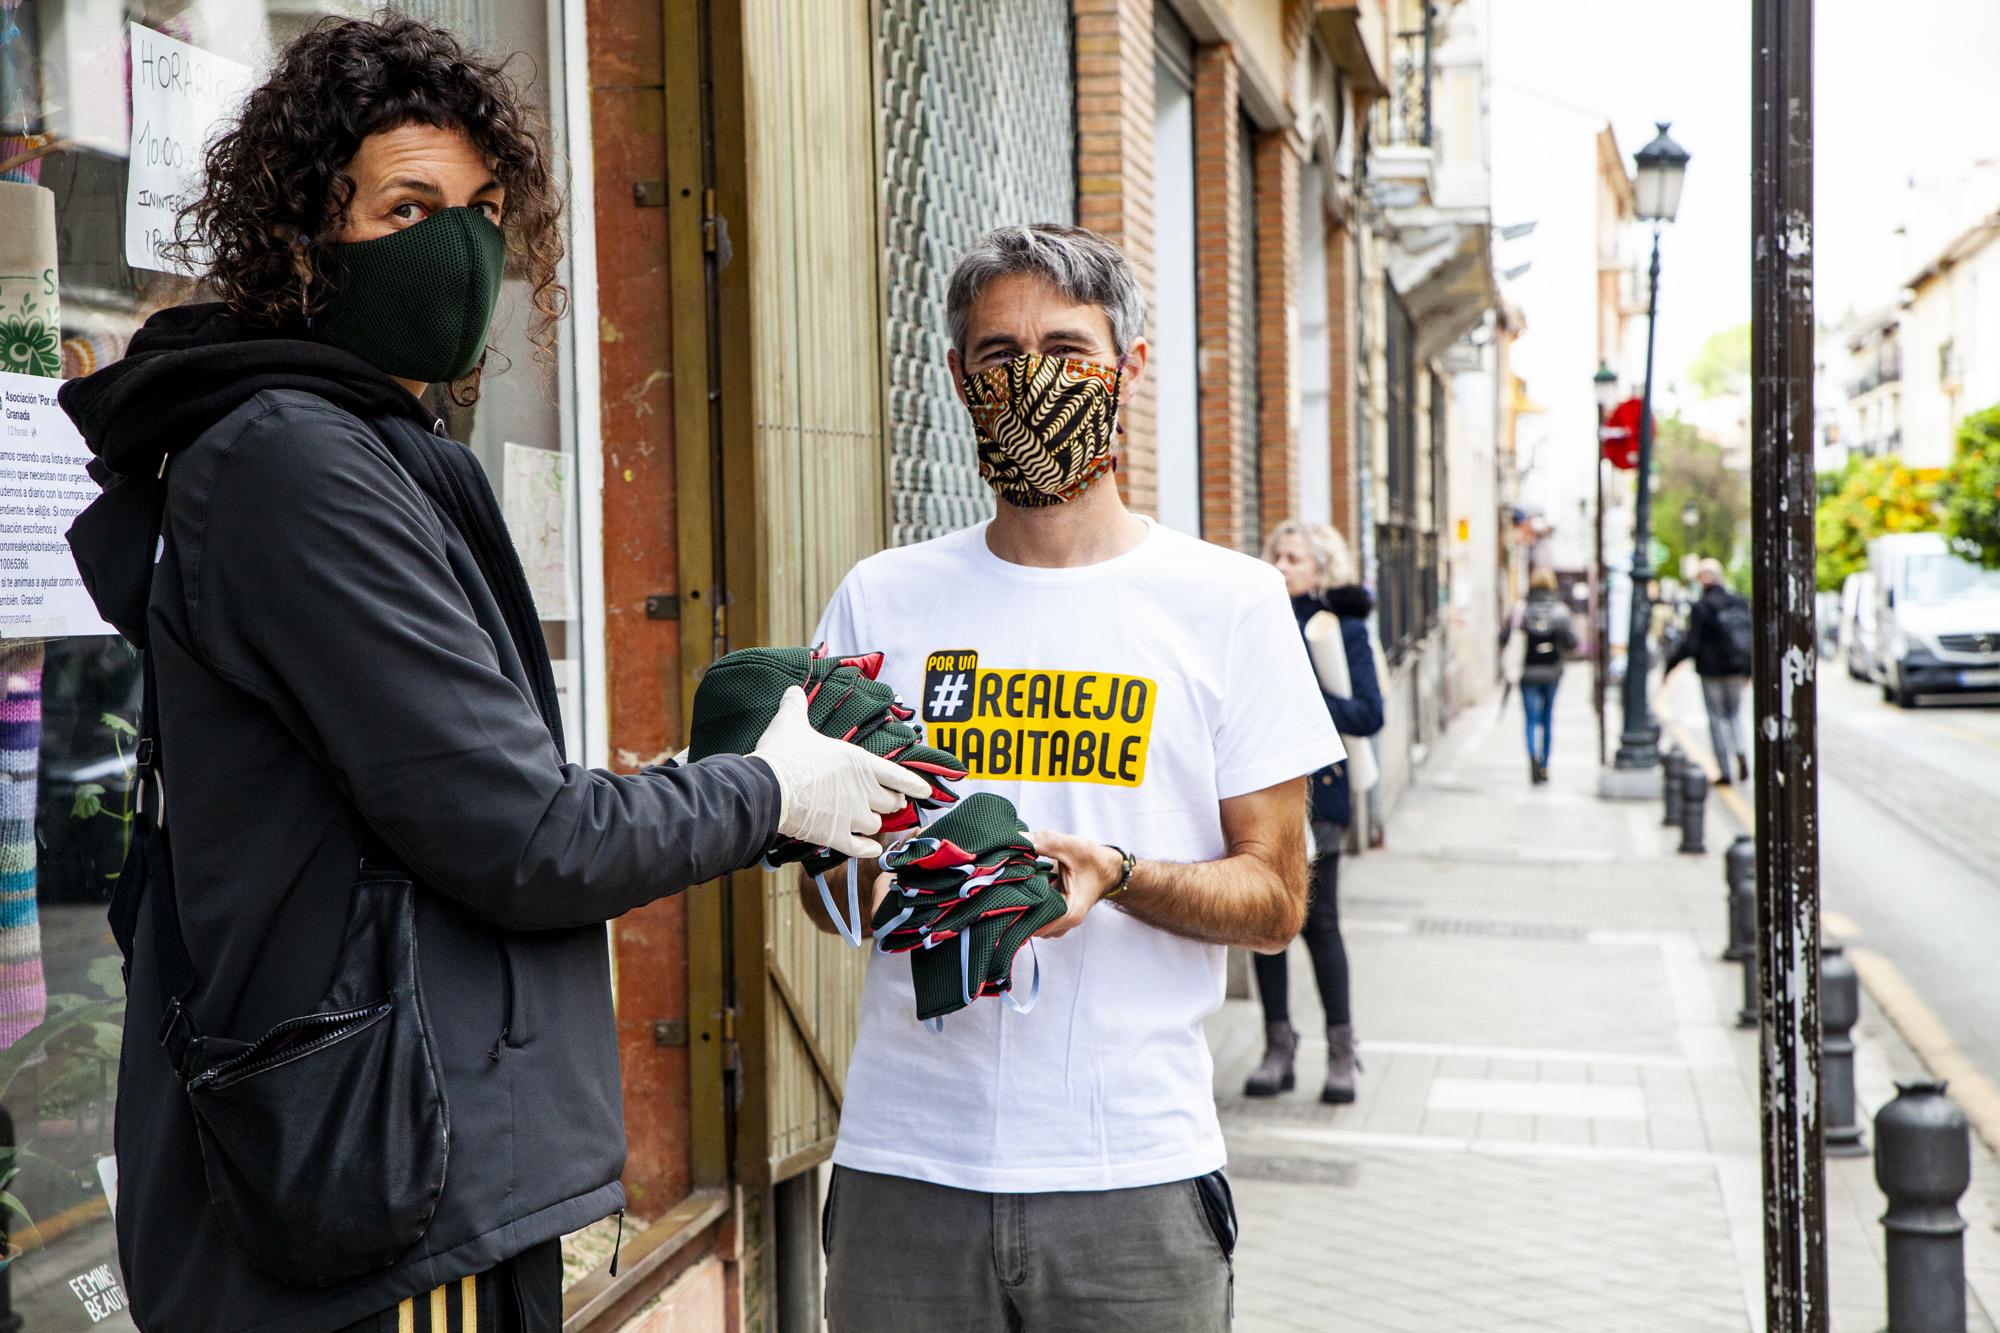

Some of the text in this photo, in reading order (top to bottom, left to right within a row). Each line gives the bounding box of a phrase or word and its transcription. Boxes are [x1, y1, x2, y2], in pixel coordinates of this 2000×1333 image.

[5, 390, 37, 405] Asociación
[5, 408, 30, 421] Granada
[16, 450, 39, 463] creando
[40, 454, 51, 464] una
[52, 453, 64, 465] lista
[65, 454, 72, 465] de
[17, 469, 29, 482] que
[29, 469, 57, 481] necesitan
[57, 472, 68, 482] con
[28, 486, 45, 498] diario
[46, 489, 57, 499] con
[57, 488, 63, 499] la
[64, 490, 85, 502] compra,
[26, 504, 34, 516] de
[53, 506, 59, 517] Si
[1, 577, 7, 588] si
[7, 578, 13, 588] te
[14, 576, 35, 588] animas
[41, 576, 59, 590] ayudar
[59, 578, 74, 587] como
[20, 593, 44, 606] Gracias!
[927, 654, 977, 672] POR UN
